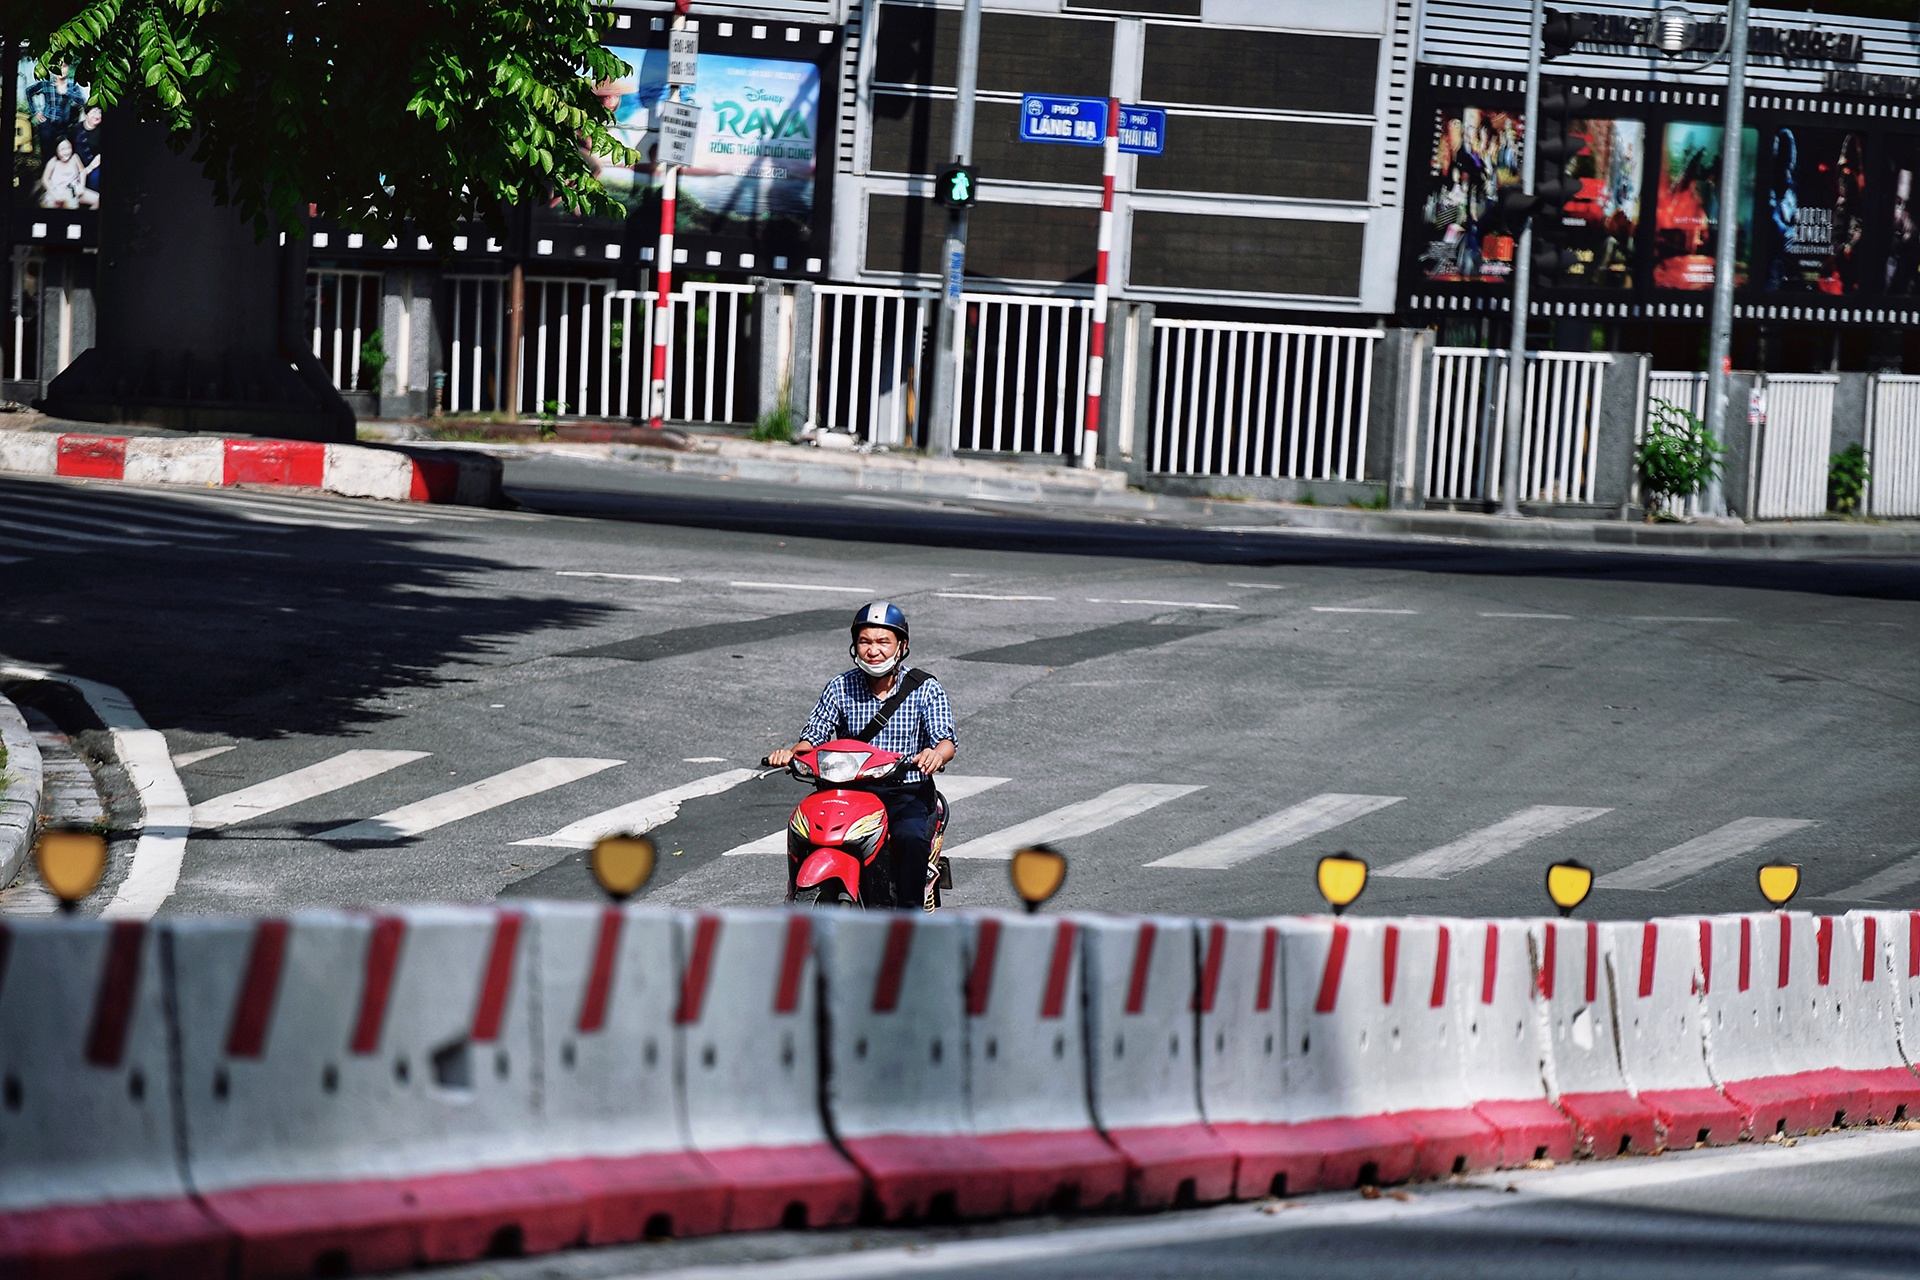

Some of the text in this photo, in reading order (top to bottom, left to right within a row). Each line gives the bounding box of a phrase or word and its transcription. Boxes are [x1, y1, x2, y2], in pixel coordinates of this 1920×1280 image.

[712, 100, 811, 140] RAYA
[1051, 102, 1080, 116] PHỐ
[1030, 115, 1097, 140] LÁNG HẠ
